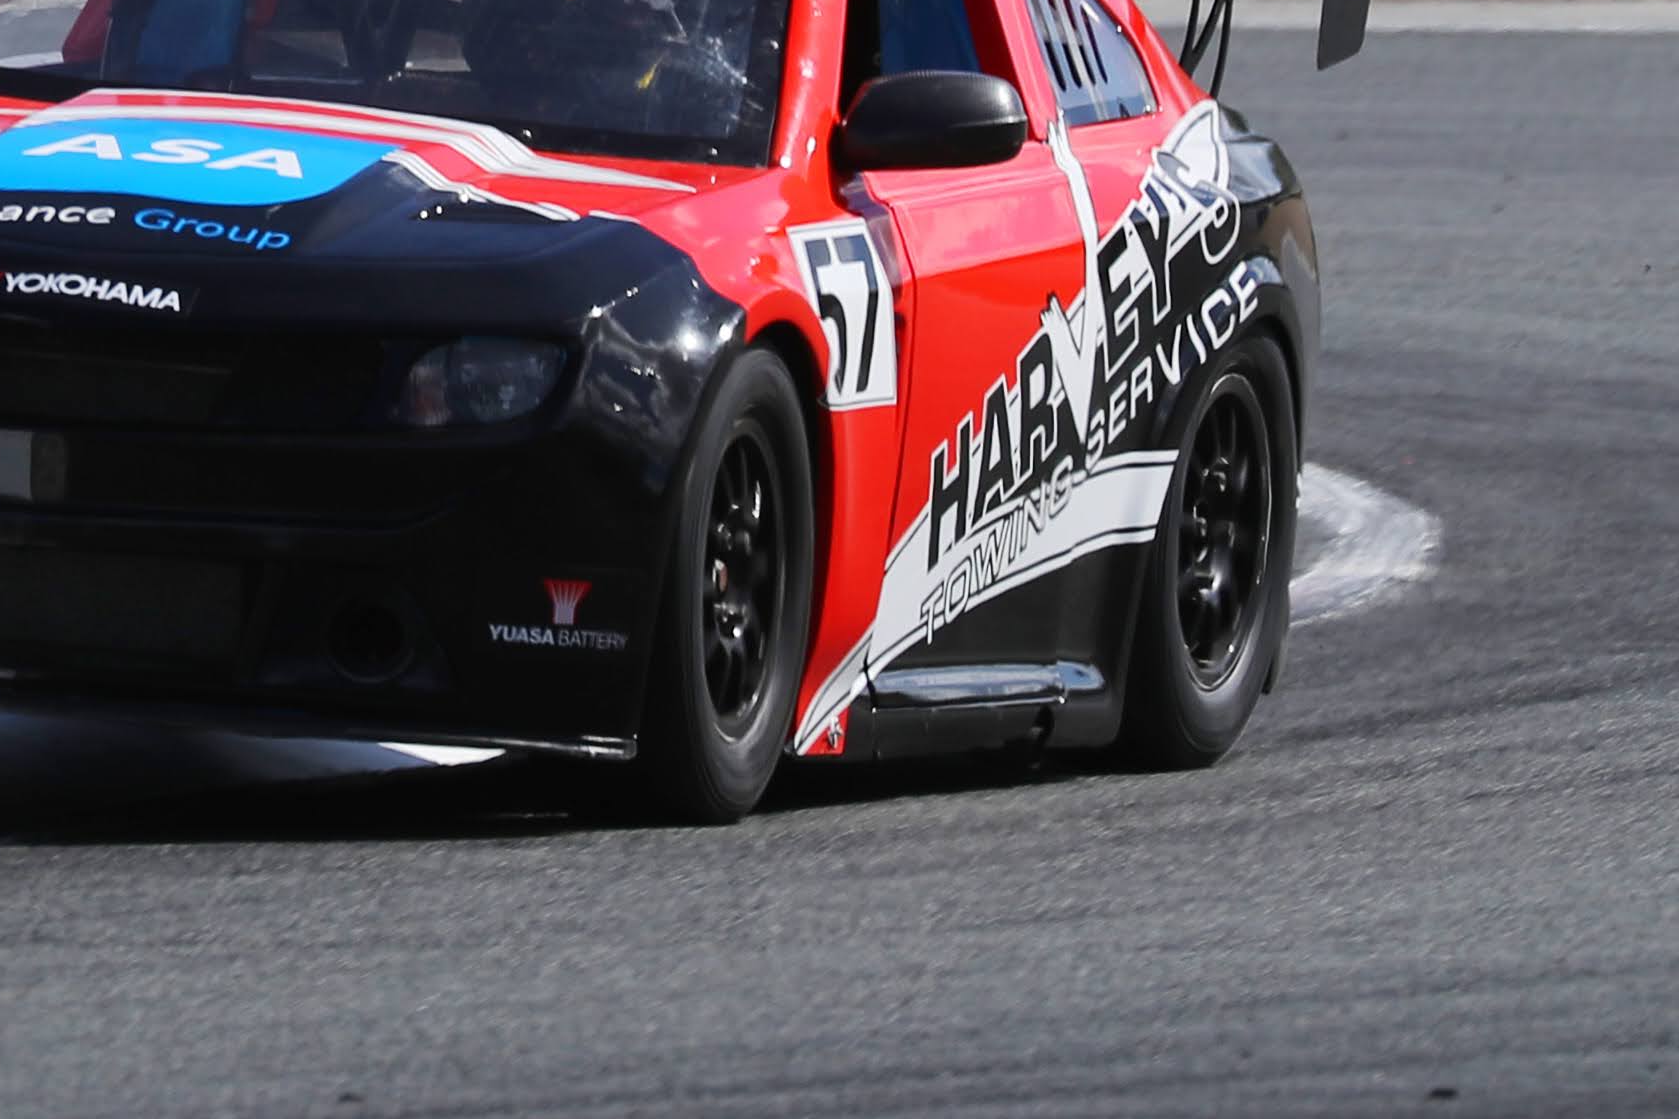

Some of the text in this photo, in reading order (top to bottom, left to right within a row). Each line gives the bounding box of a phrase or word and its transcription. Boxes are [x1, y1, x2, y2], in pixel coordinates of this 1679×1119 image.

[22, 132, 304, 180] ASA
[133, 207, 292, 251] Group
[3, 271, 182, 313] YOKOHAMA
[804, 234, 879, 396] 57
[920, 260, 1259, 646] TOWING SERVICE
[488, 623, 630, 652] YUASA BATTERY
